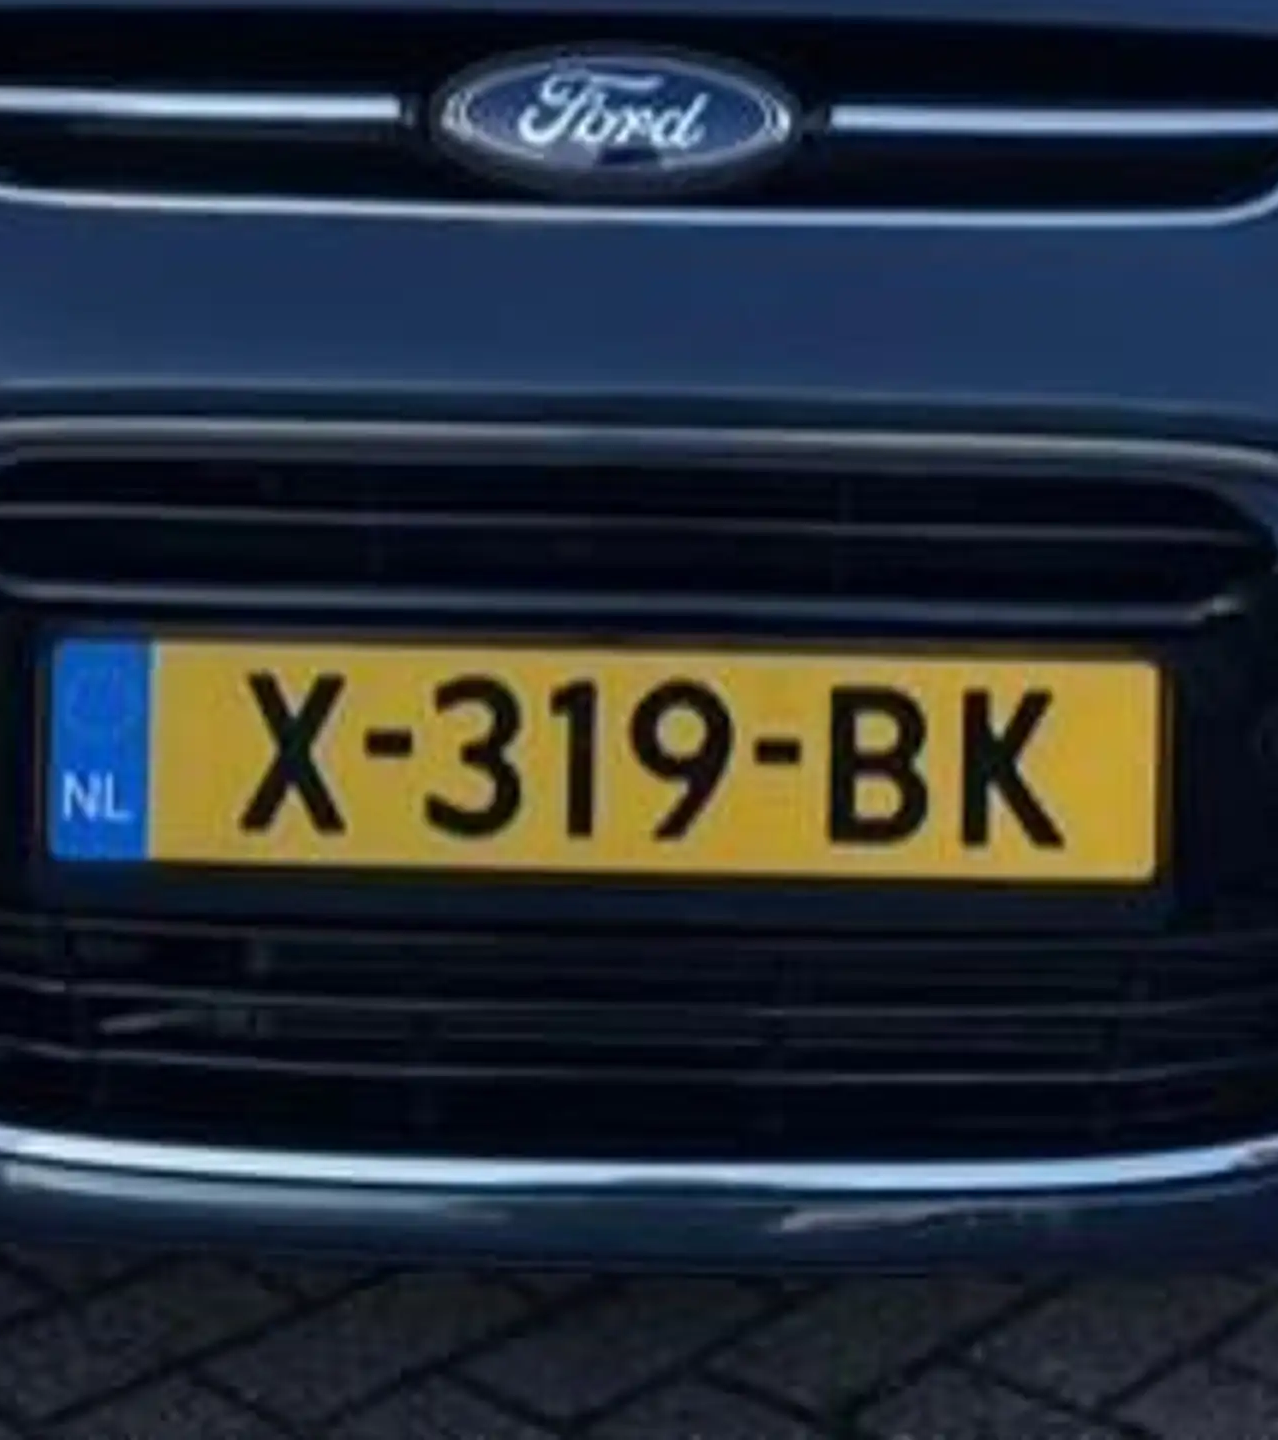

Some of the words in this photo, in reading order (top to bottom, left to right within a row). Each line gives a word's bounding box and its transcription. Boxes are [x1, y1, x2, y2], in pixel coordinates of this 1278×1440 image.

[517, 67, 710, 149] Ford
[62, 770, 133, 824] NL
[236, 670, 1066, 850] X-319-BK
